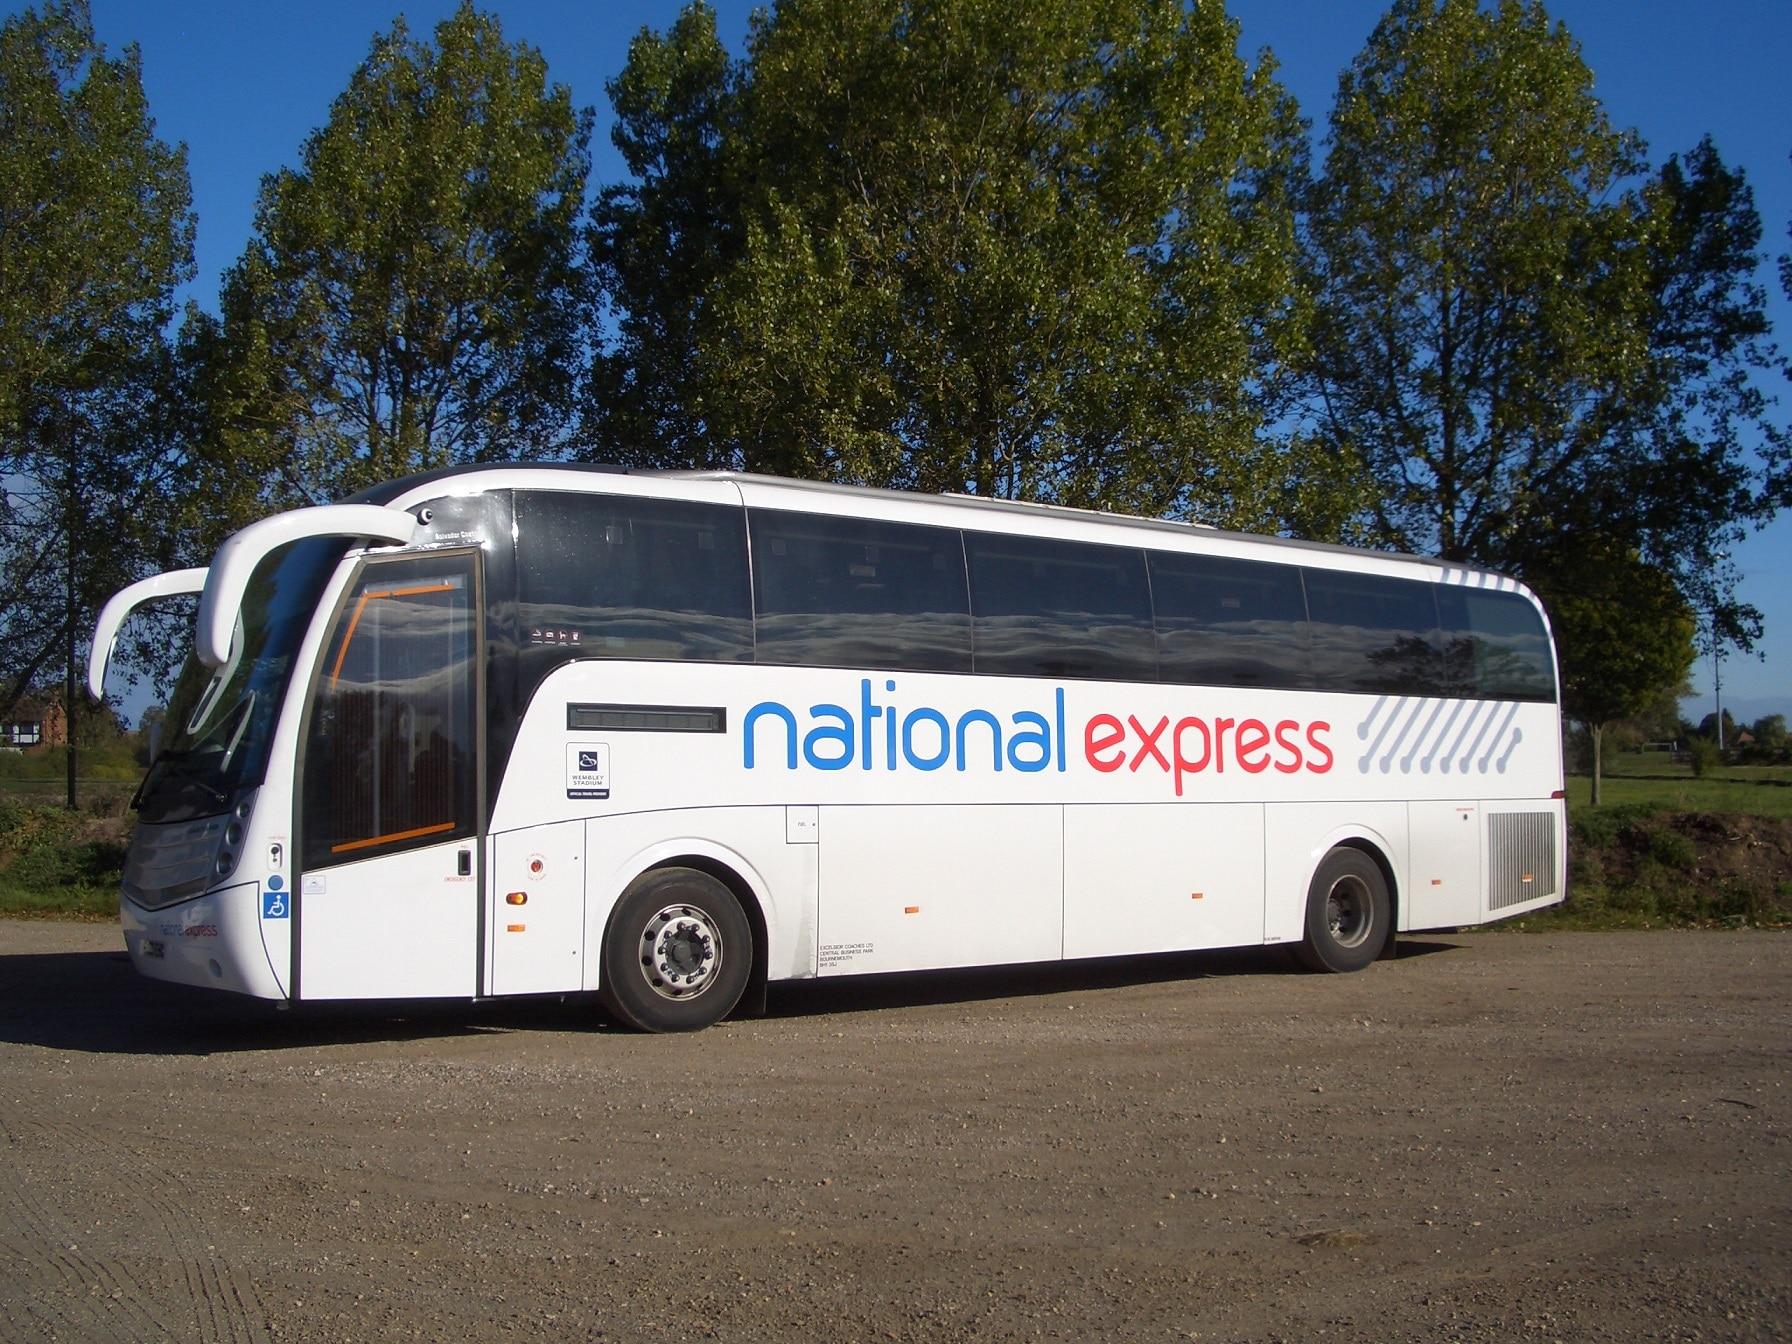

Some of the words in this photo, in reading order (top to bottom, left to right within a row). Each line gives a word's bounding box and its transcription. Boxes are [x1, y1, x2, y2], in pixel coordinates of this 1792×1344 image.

[743, 678, 1066, 772] national
[1084, 713, 1334, 796] express
[184, 925, 218, 939] express
